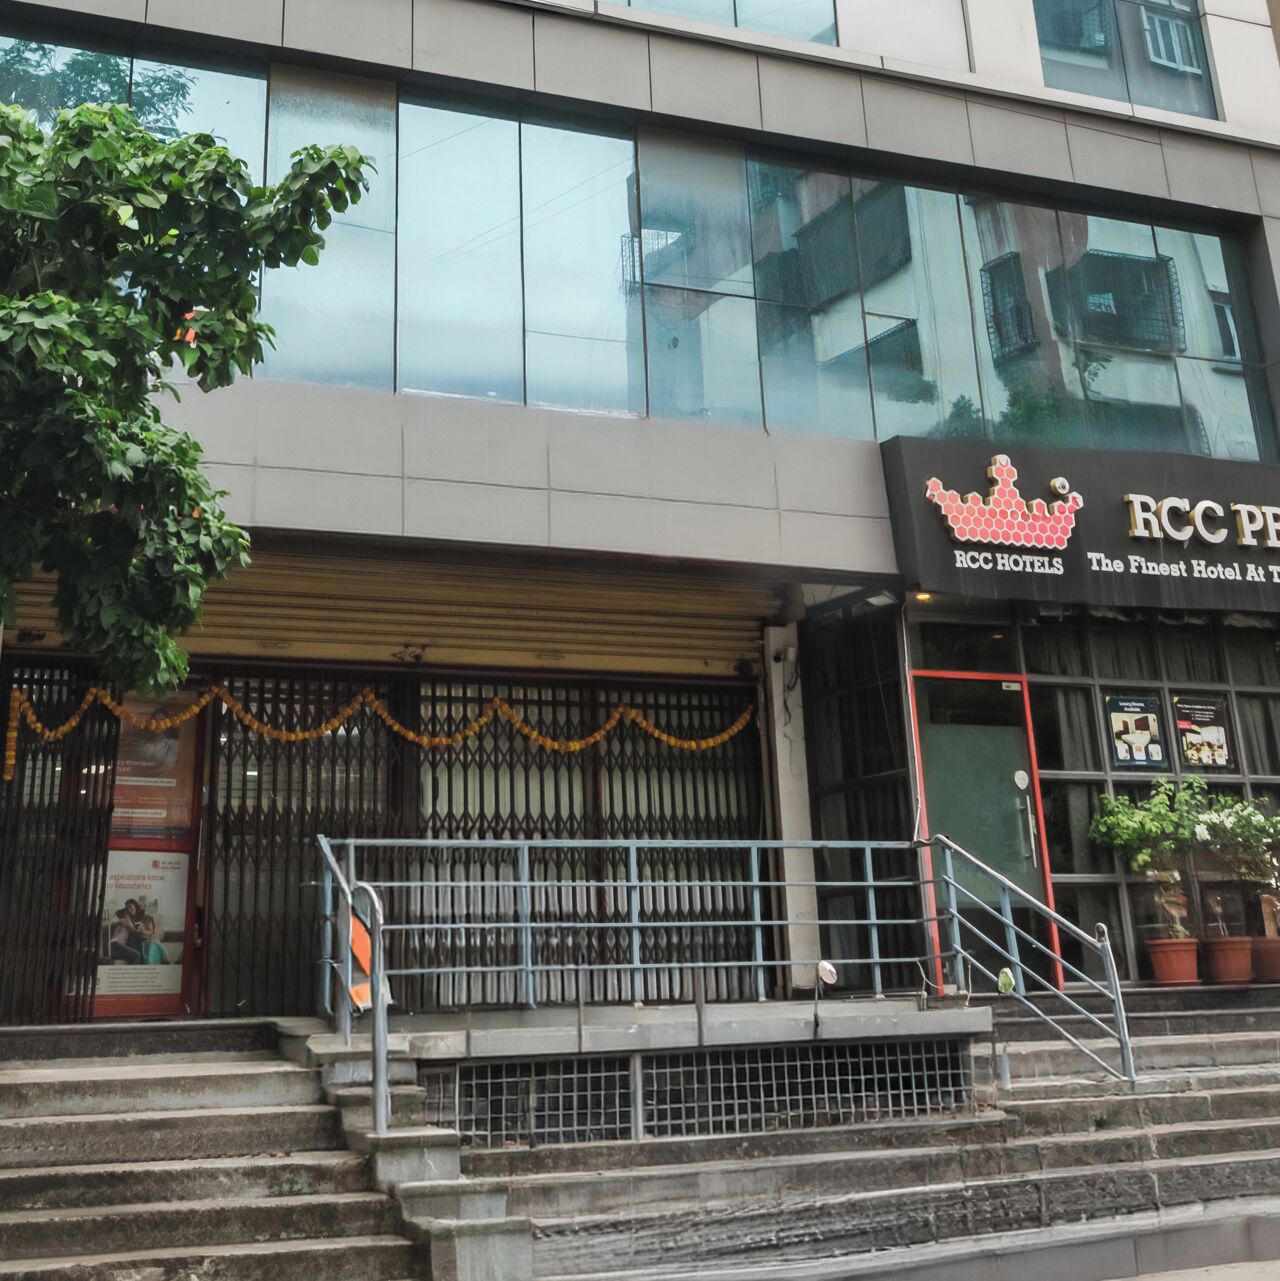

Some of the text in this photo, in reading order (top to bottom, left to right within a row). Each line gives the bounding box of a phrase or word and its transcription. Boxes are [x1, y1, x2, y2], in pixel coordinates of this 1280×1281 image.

[1123, 493, 1229, 545] RCC
[954, 550, 1065, 575] RCC HOTELS
[1086, 552, 1124, 573] The
[1128, 555, 1188, 578] Finest
[1190, 559, 1243, 581] Hotel
[1245, 563, 1266, 583] At
[147, 873, 166, 881] know
